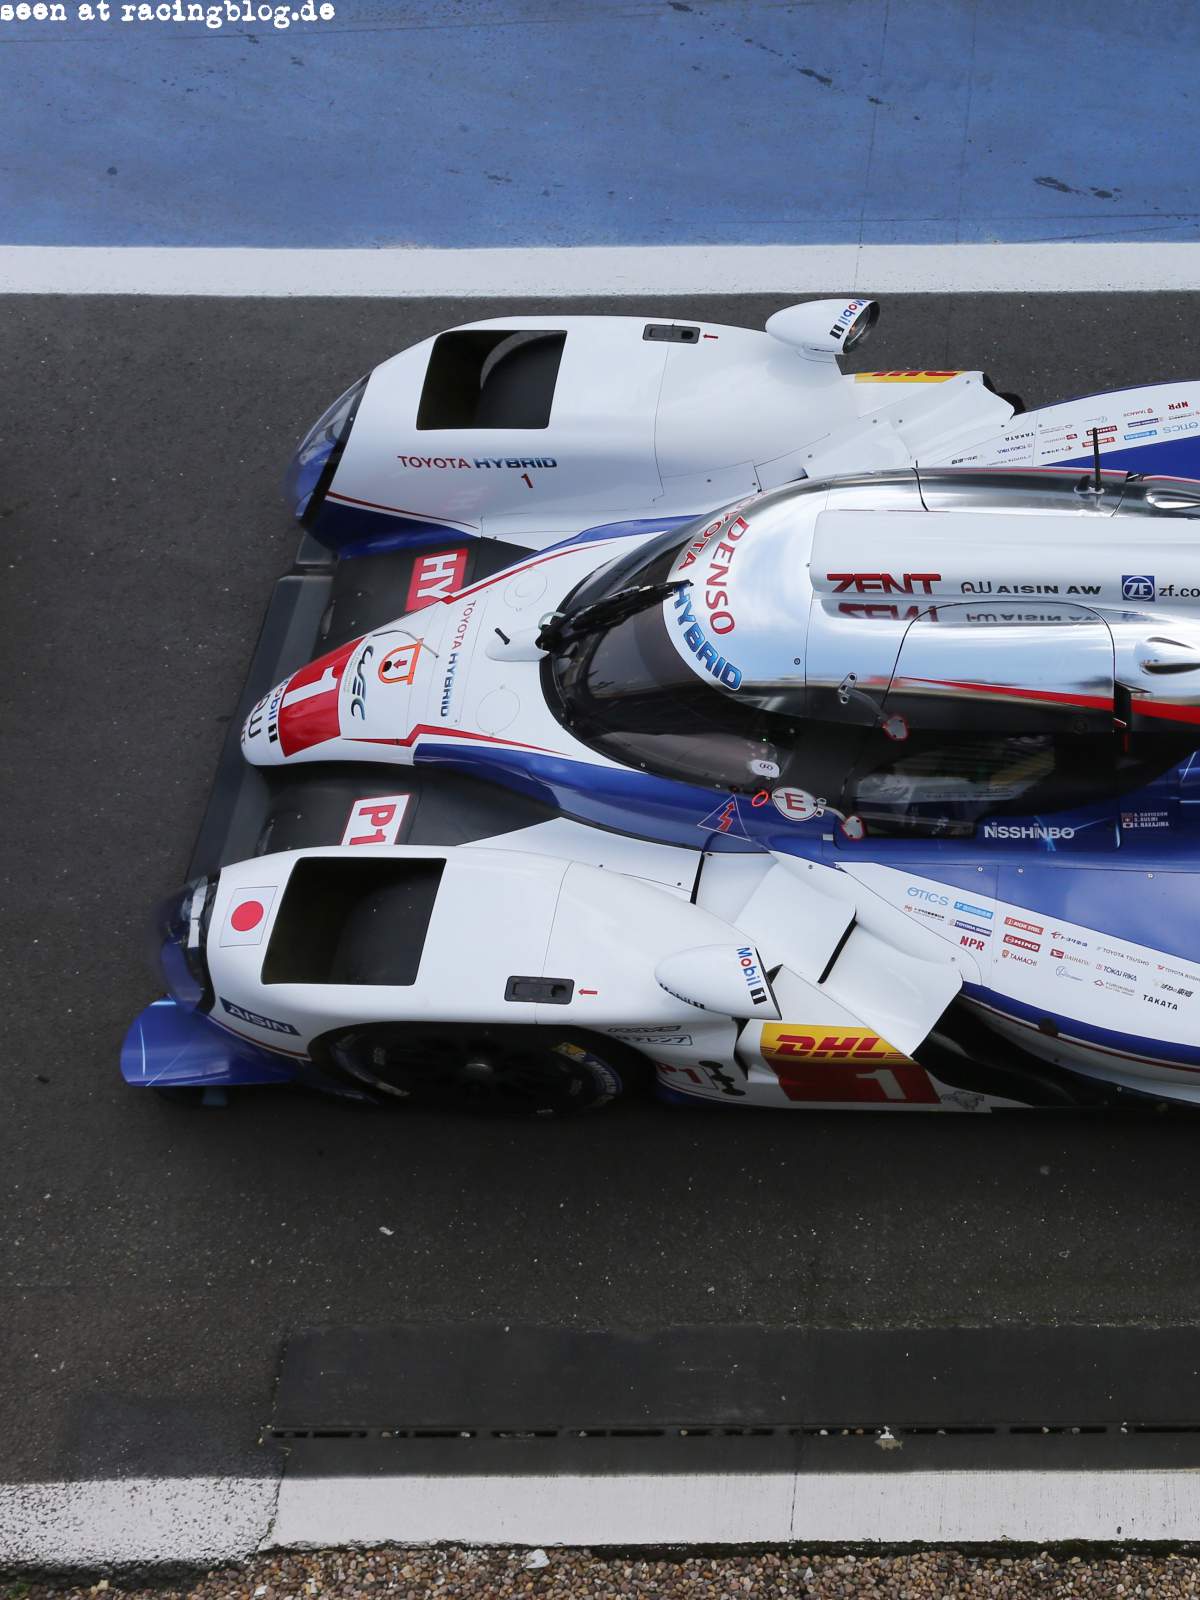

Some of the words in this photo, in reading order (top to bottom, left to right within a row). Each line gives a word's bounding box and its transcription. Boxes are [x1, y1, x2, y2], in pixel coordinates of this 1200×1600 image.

[397, 455, 472, 469] TOYOTA
[473, 457, 557, 469] HYBRID
[521, 473, 533, 488] 1
[417, 553, 457, 598] HY
[705, 516, 750, 635] DENSO
[827, 573, 941, 594] ZENT
[996, 585, 1058, 594] AISIN
[1065, 585, 1101, 595] AW
[452, 600, 477, 649] TOYOTA
[281, 666, 337, 708] 1
[440, 653, 458, 717] HYBRID
[784, 792, 806, 812] E
[349, 804, 397, 845] P1
[907, 887, 949, 906] OTICS
[960, 936, 985, 951] NPR
[1014, 939, 1039, 950] HINO
[1103, 948, 1124, 958] TOYOTA
[736, 947, 761, 986] Mobil
[1143, 994, 1178, 1010] TAKATA
[228, 1004, 292, 1033] AISIN
[775, 1034, 886, 1059] DHL
[856, 1069, 907, 1099] 1
